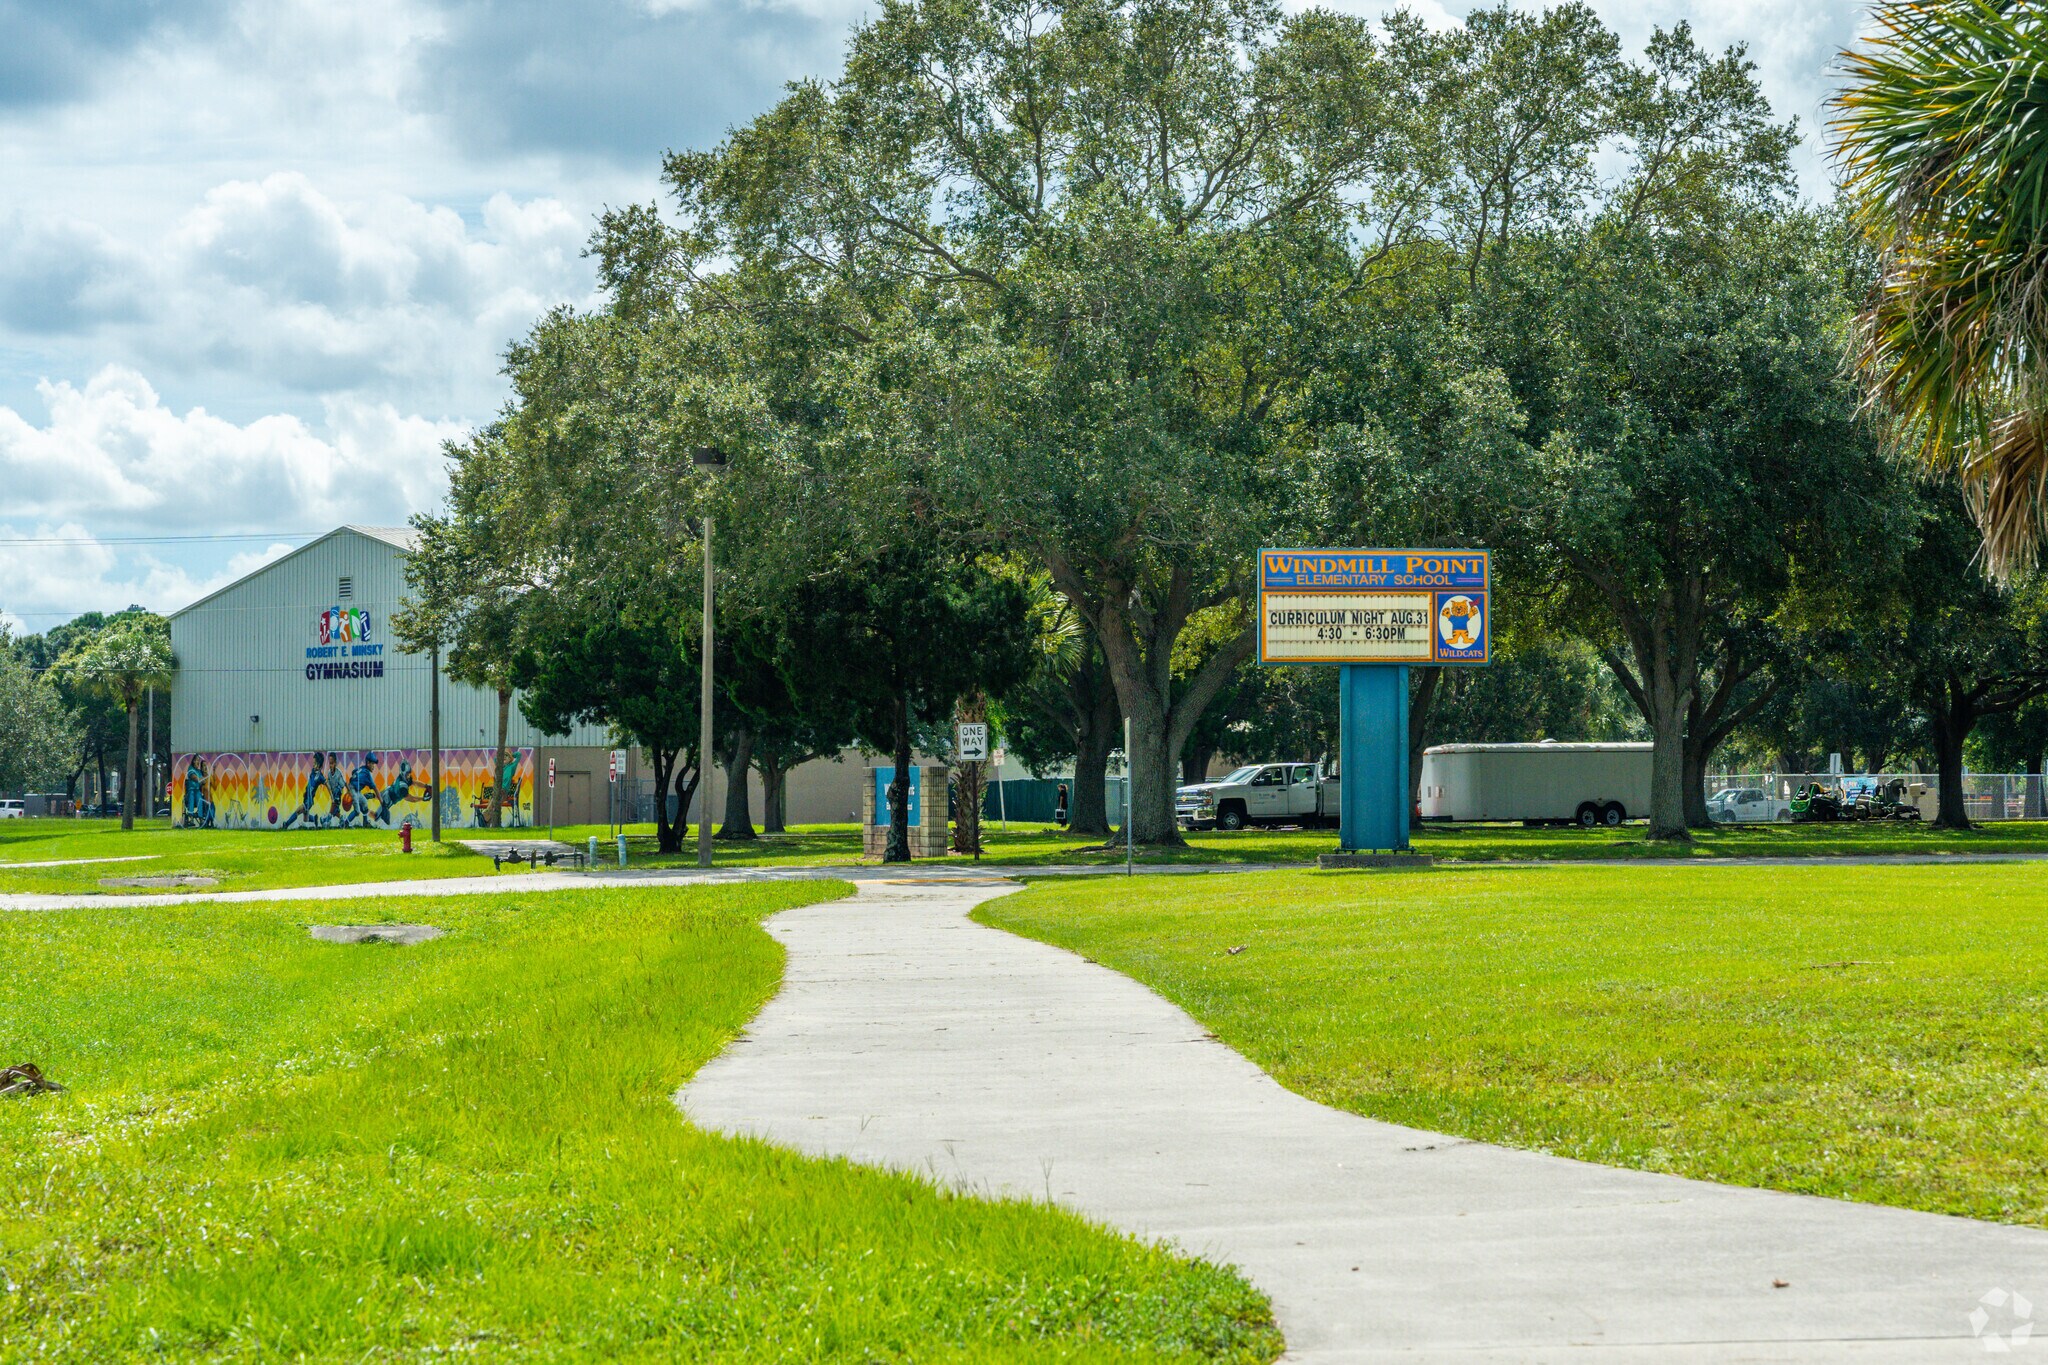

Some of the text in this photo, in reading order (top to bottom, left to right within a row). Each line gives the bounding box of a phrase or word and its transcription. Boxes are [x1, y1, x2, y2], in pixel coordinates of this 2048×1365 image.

[1266, 556, 1483, 574] WINDMILL POINT
[1296, 574, 1453, 586] ELEMENTARY SCHOOL
[1270, 611, 1429, 625] CURRICULUM NIGHT AUG.31
[1317, 627, 1342, 640] 4:30
[1365, 627, 1406, 640] 6:30PM
[306, 644, 384, 658] ROBERT E. MINSKY
[1439, 648, 1483, 658] WILDCATS
[305, 661, 384, 680] GYMNASIUM
[962, 726, 983, 736] ONE
[962, 736, 984, 746] WAY
